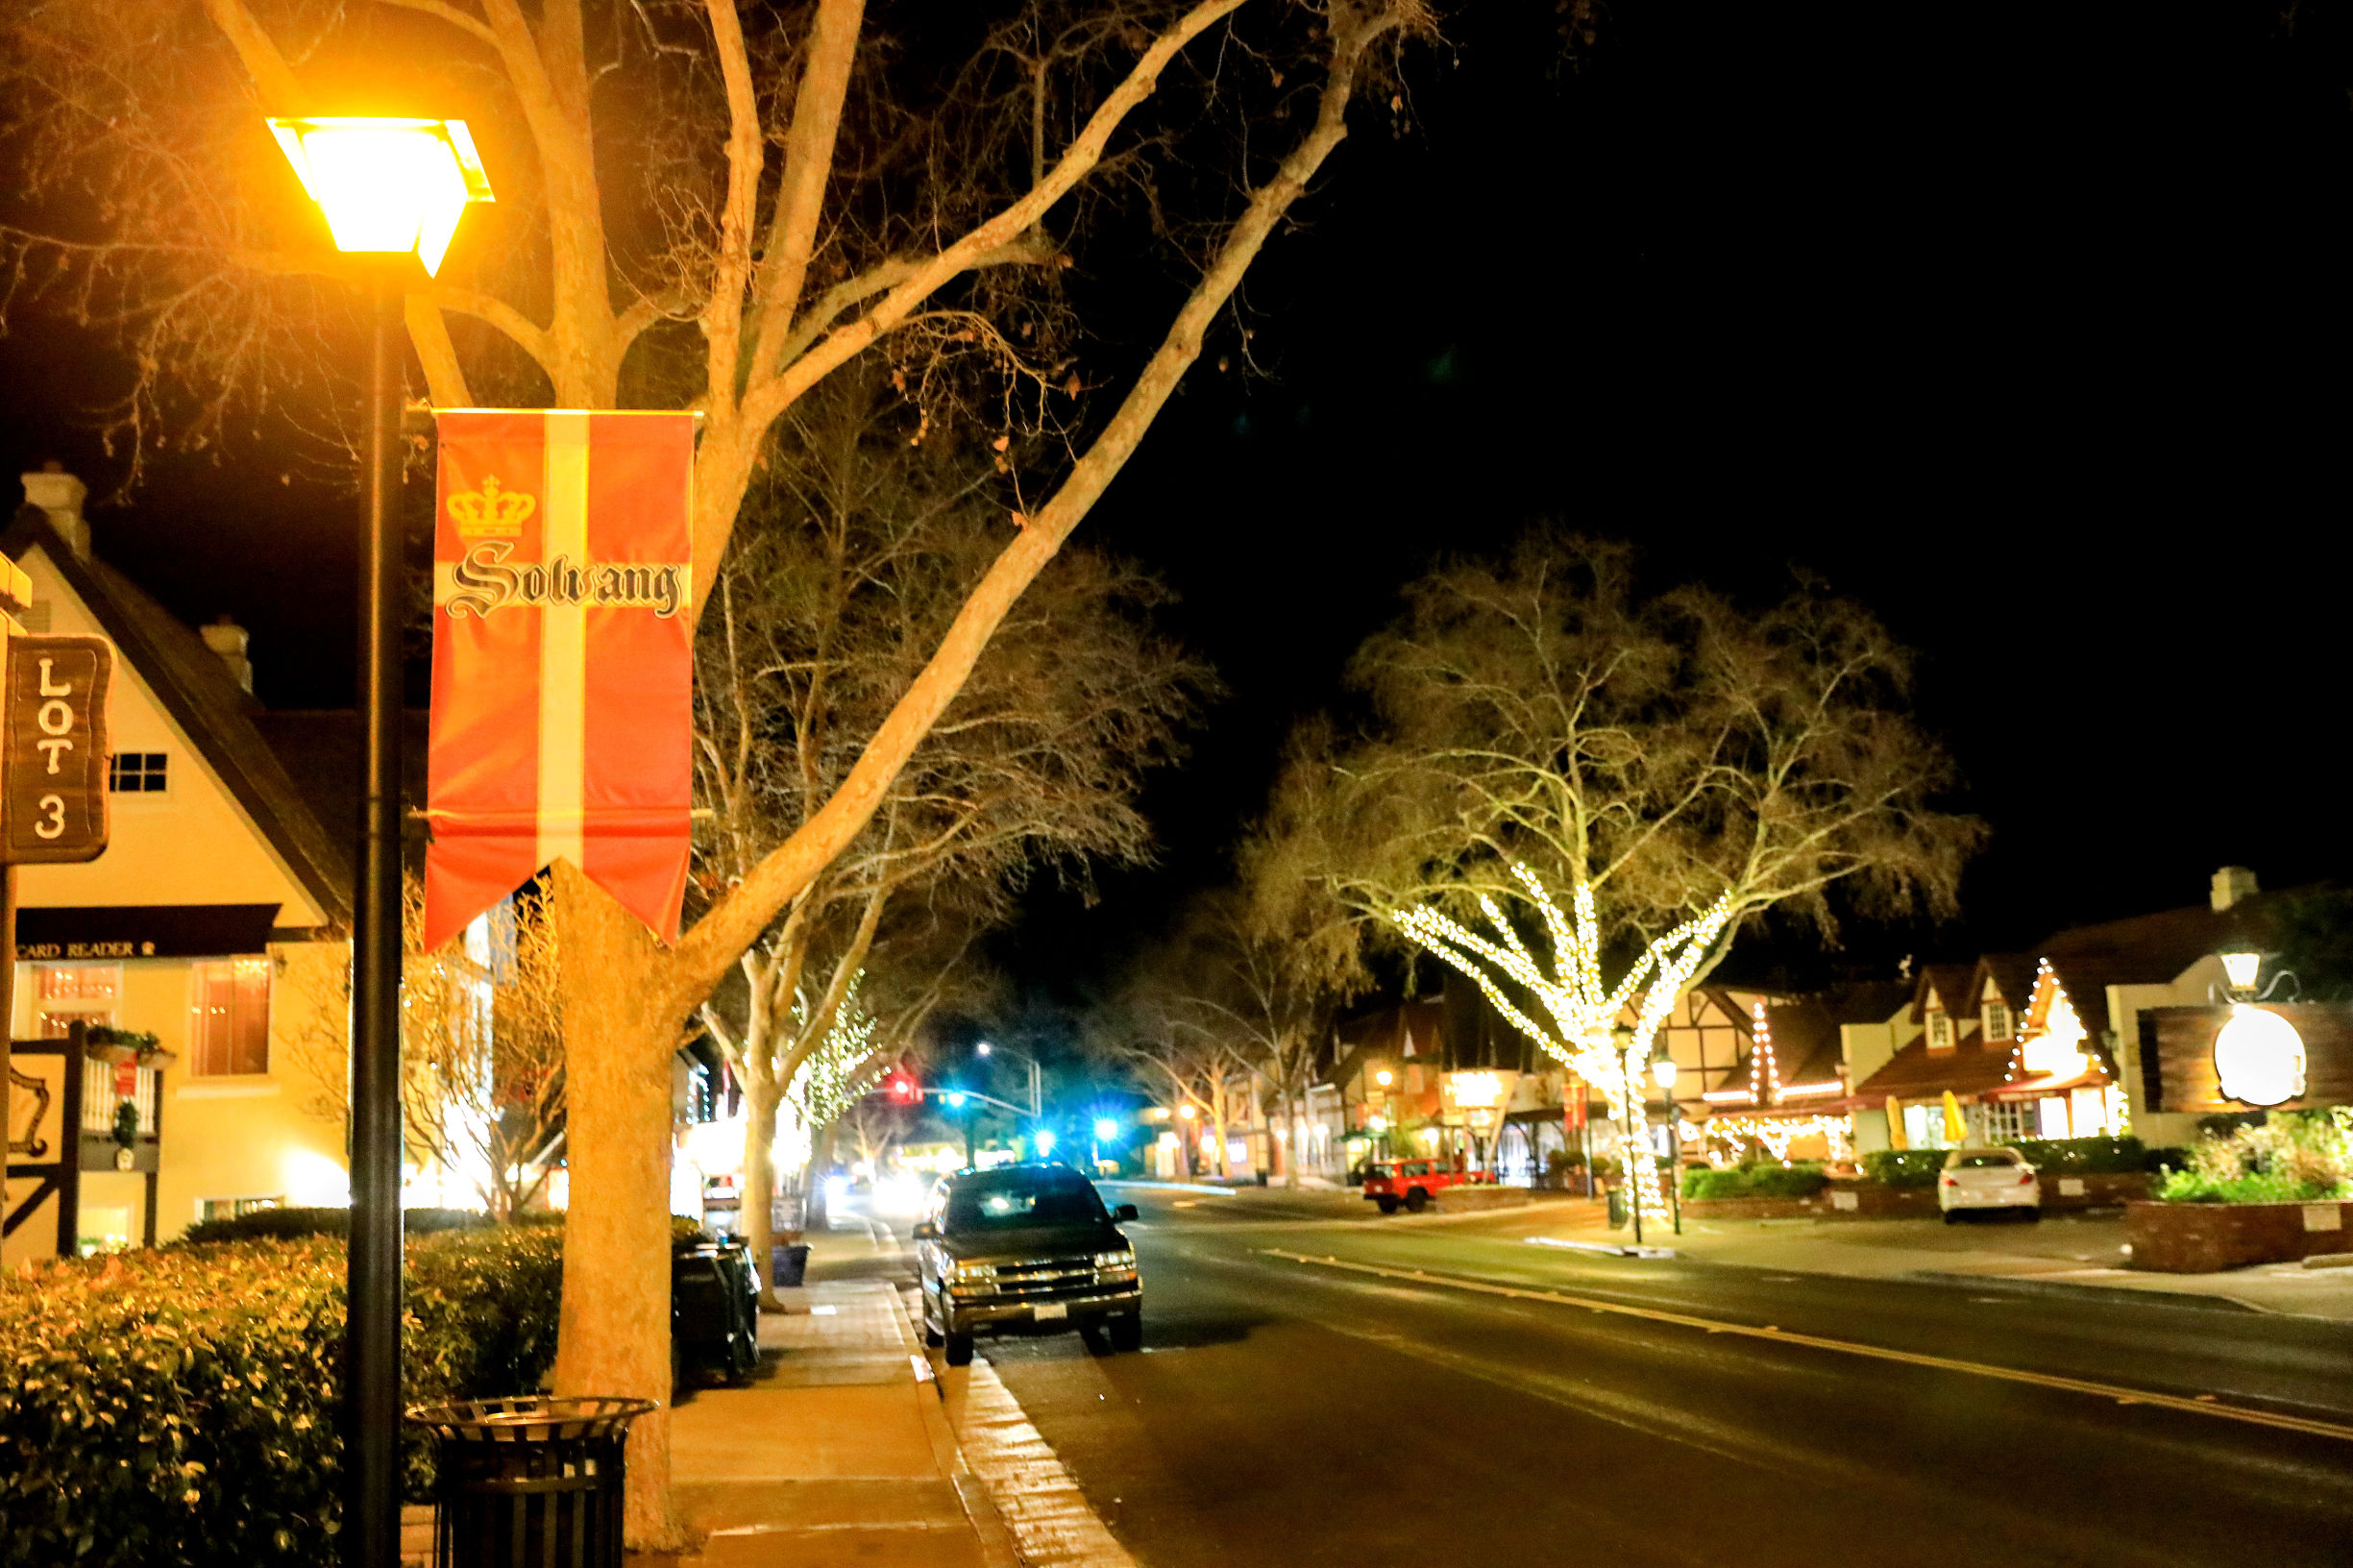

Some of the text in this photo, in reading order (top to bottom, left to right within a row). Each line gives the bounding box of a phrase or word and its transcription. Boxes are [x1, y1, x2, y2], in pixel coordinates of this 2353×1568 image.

[446, 540, 681, 618] Solvang
[35, 658, 73, 839] LOT 3
[66, 941, 134, 957] READER
